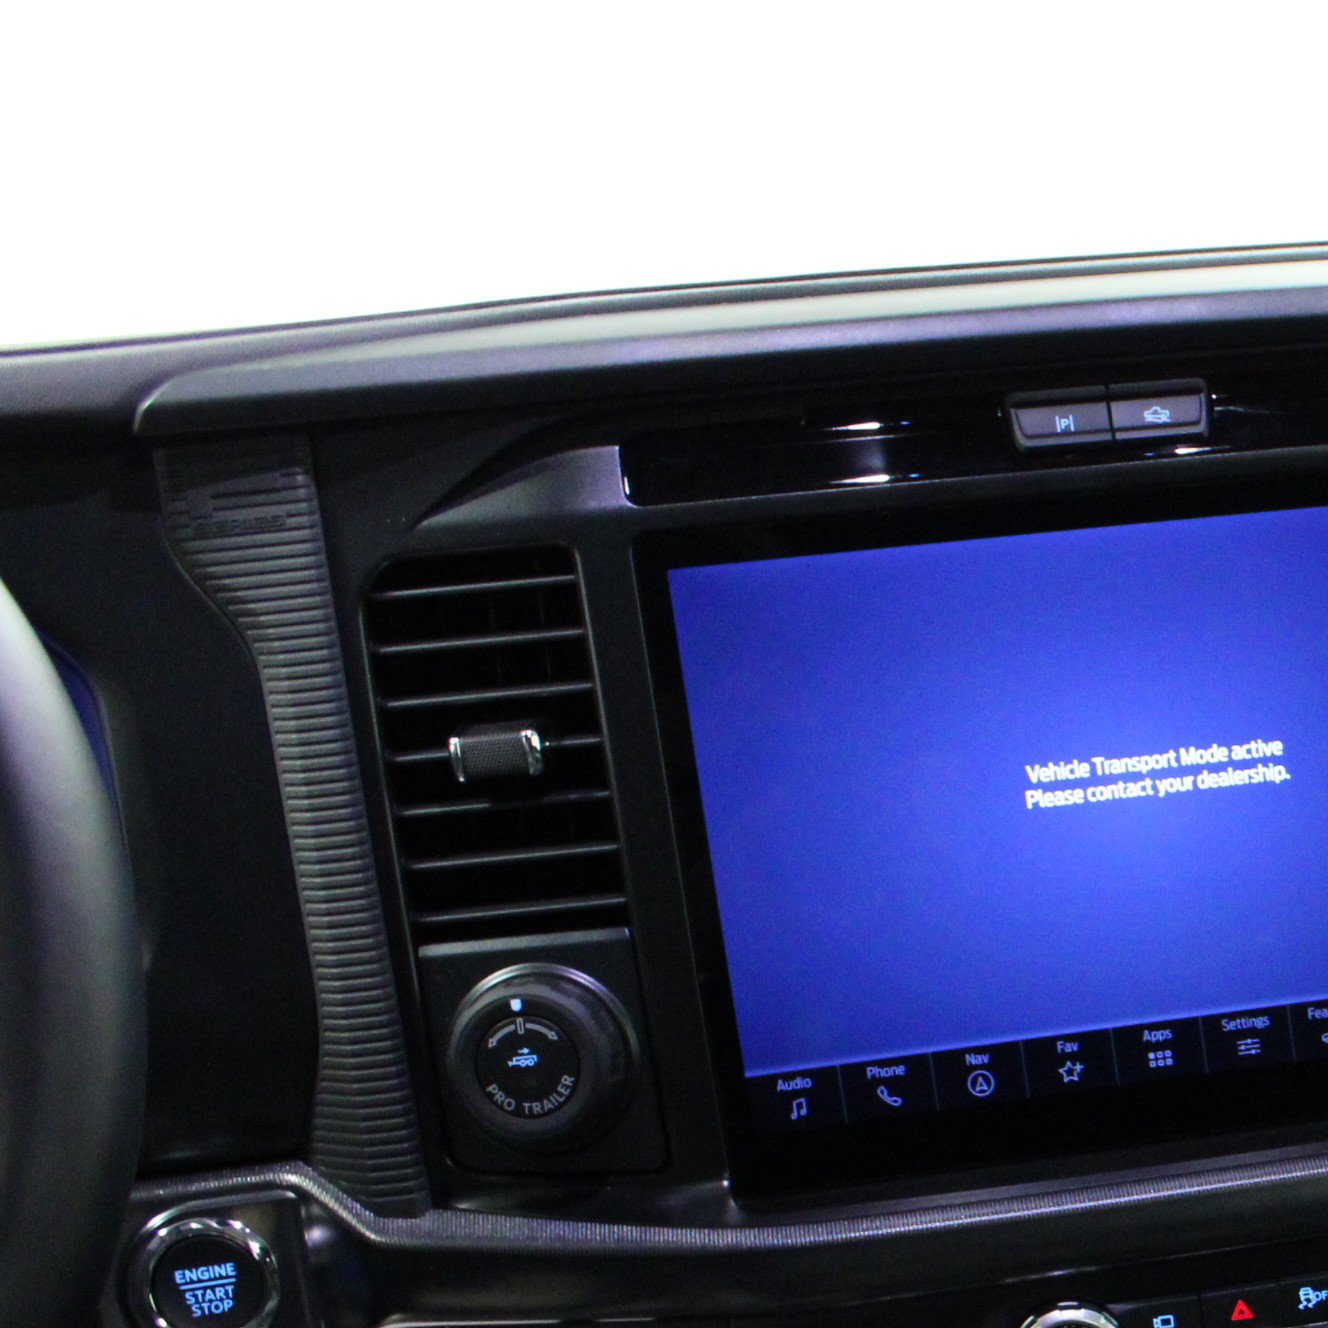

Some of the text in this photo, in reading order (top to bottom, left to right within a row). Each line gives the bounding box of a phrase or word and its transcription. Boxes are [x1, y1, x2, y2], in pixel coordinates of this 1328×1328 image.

[1025, 738, 1284, 784] Vehicle Transport Mode active
[1024, 762, 1292, 810] Please contact your dealership.
[1221, 1014, 1271, 1032] Settings
[1142, 1028, 1173, 1043] Apps
[1056, 1040, 1080, 1054] Fav
[965, 1052, 990, 1066] Nav
[866, 1064, 906, 1080] Phone
[777, 1076, 812, 1092] Audio
[486, 1074, 577, 1116] PRO TRAILER
[174, 1262, 237, 1284] ENGINE
[185, 1285, 235, 1305] START
[191, 1299, 234, 1318] STOP
